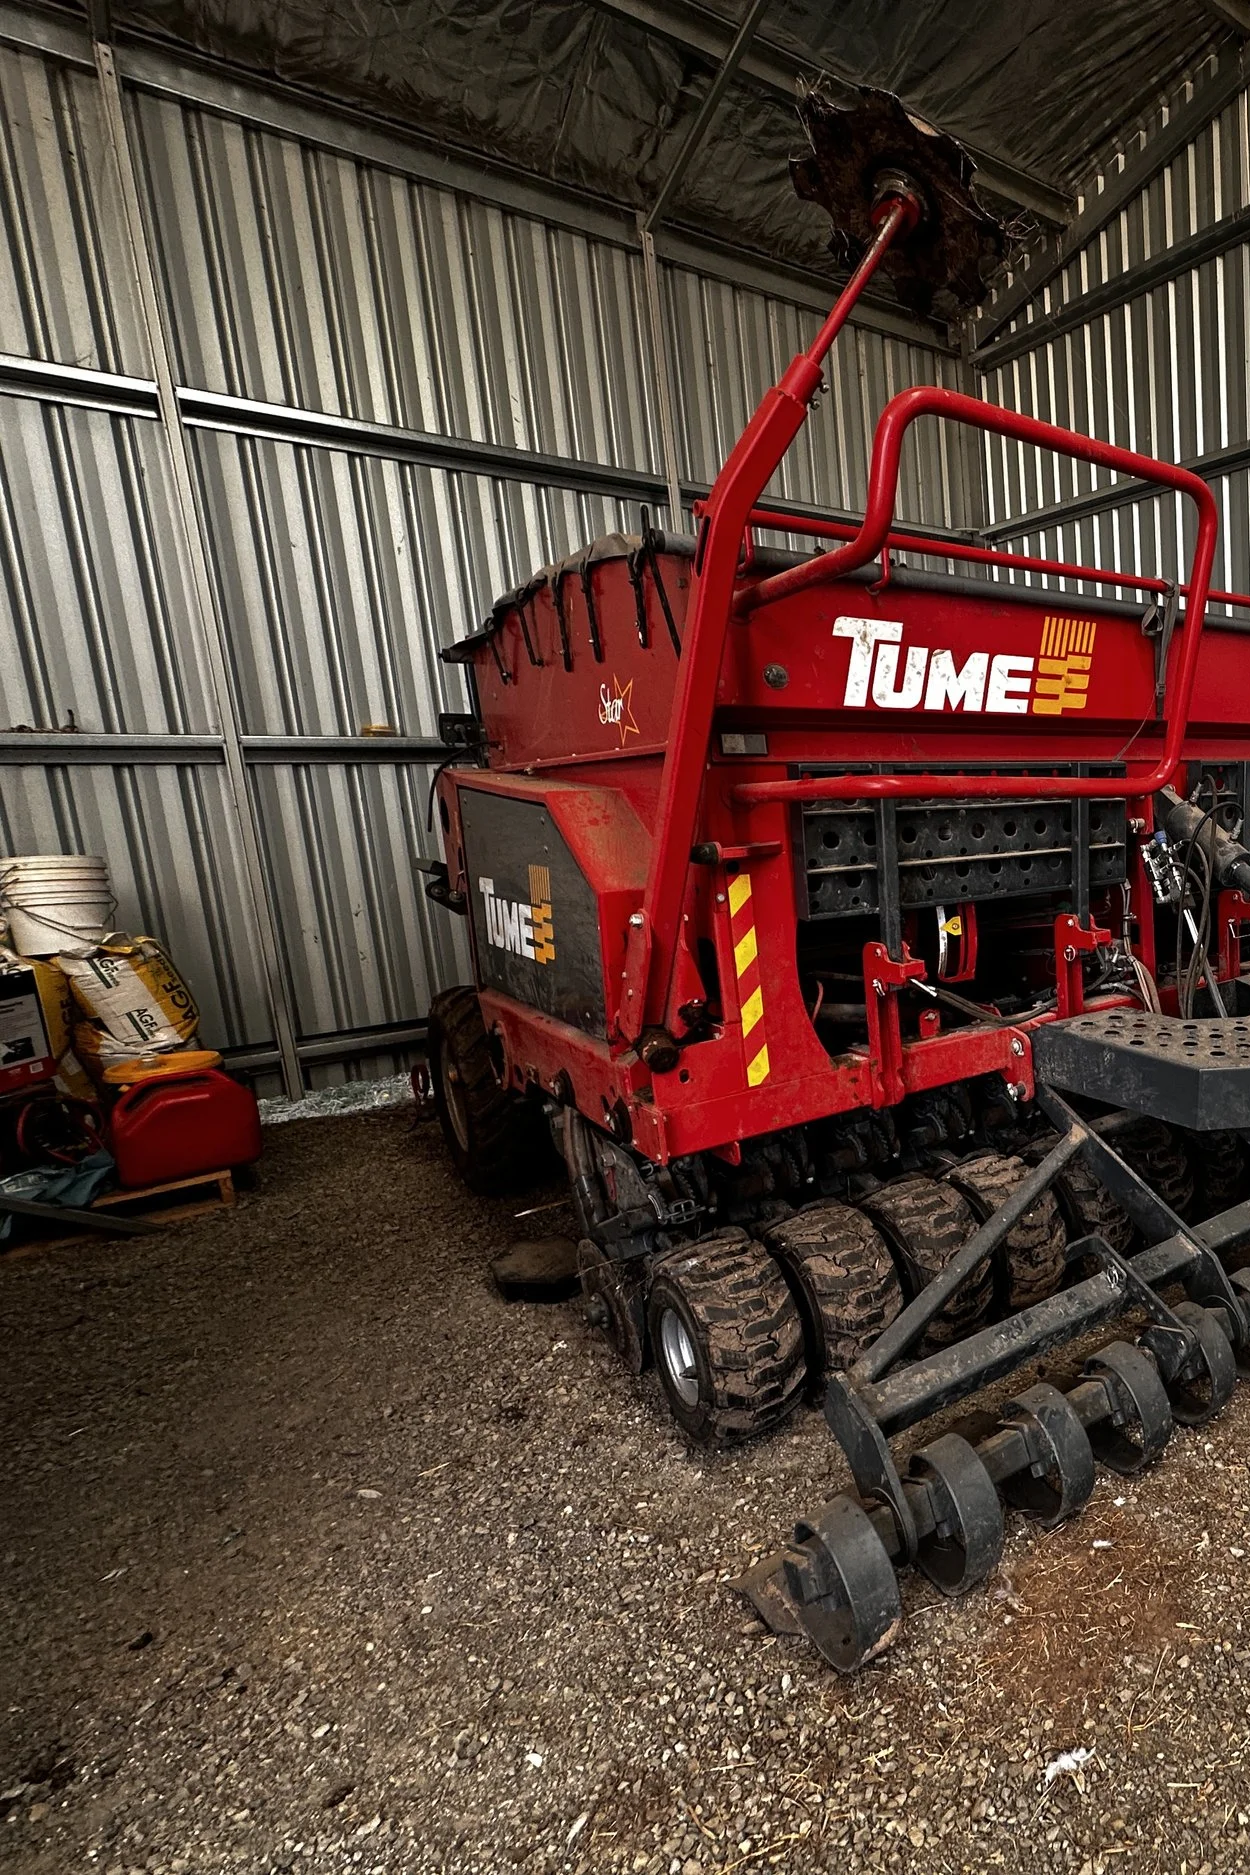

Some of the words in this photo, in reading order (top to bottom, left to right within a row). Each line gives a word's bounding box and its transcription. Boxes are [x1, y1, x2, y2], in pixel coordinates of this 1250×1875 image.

[832, 616, 1034, 713] TUME
[599, 683, 624, 725] Star
[479, 876, 536, 961] TUME
[134, 1008, 158, 1029] AGF
